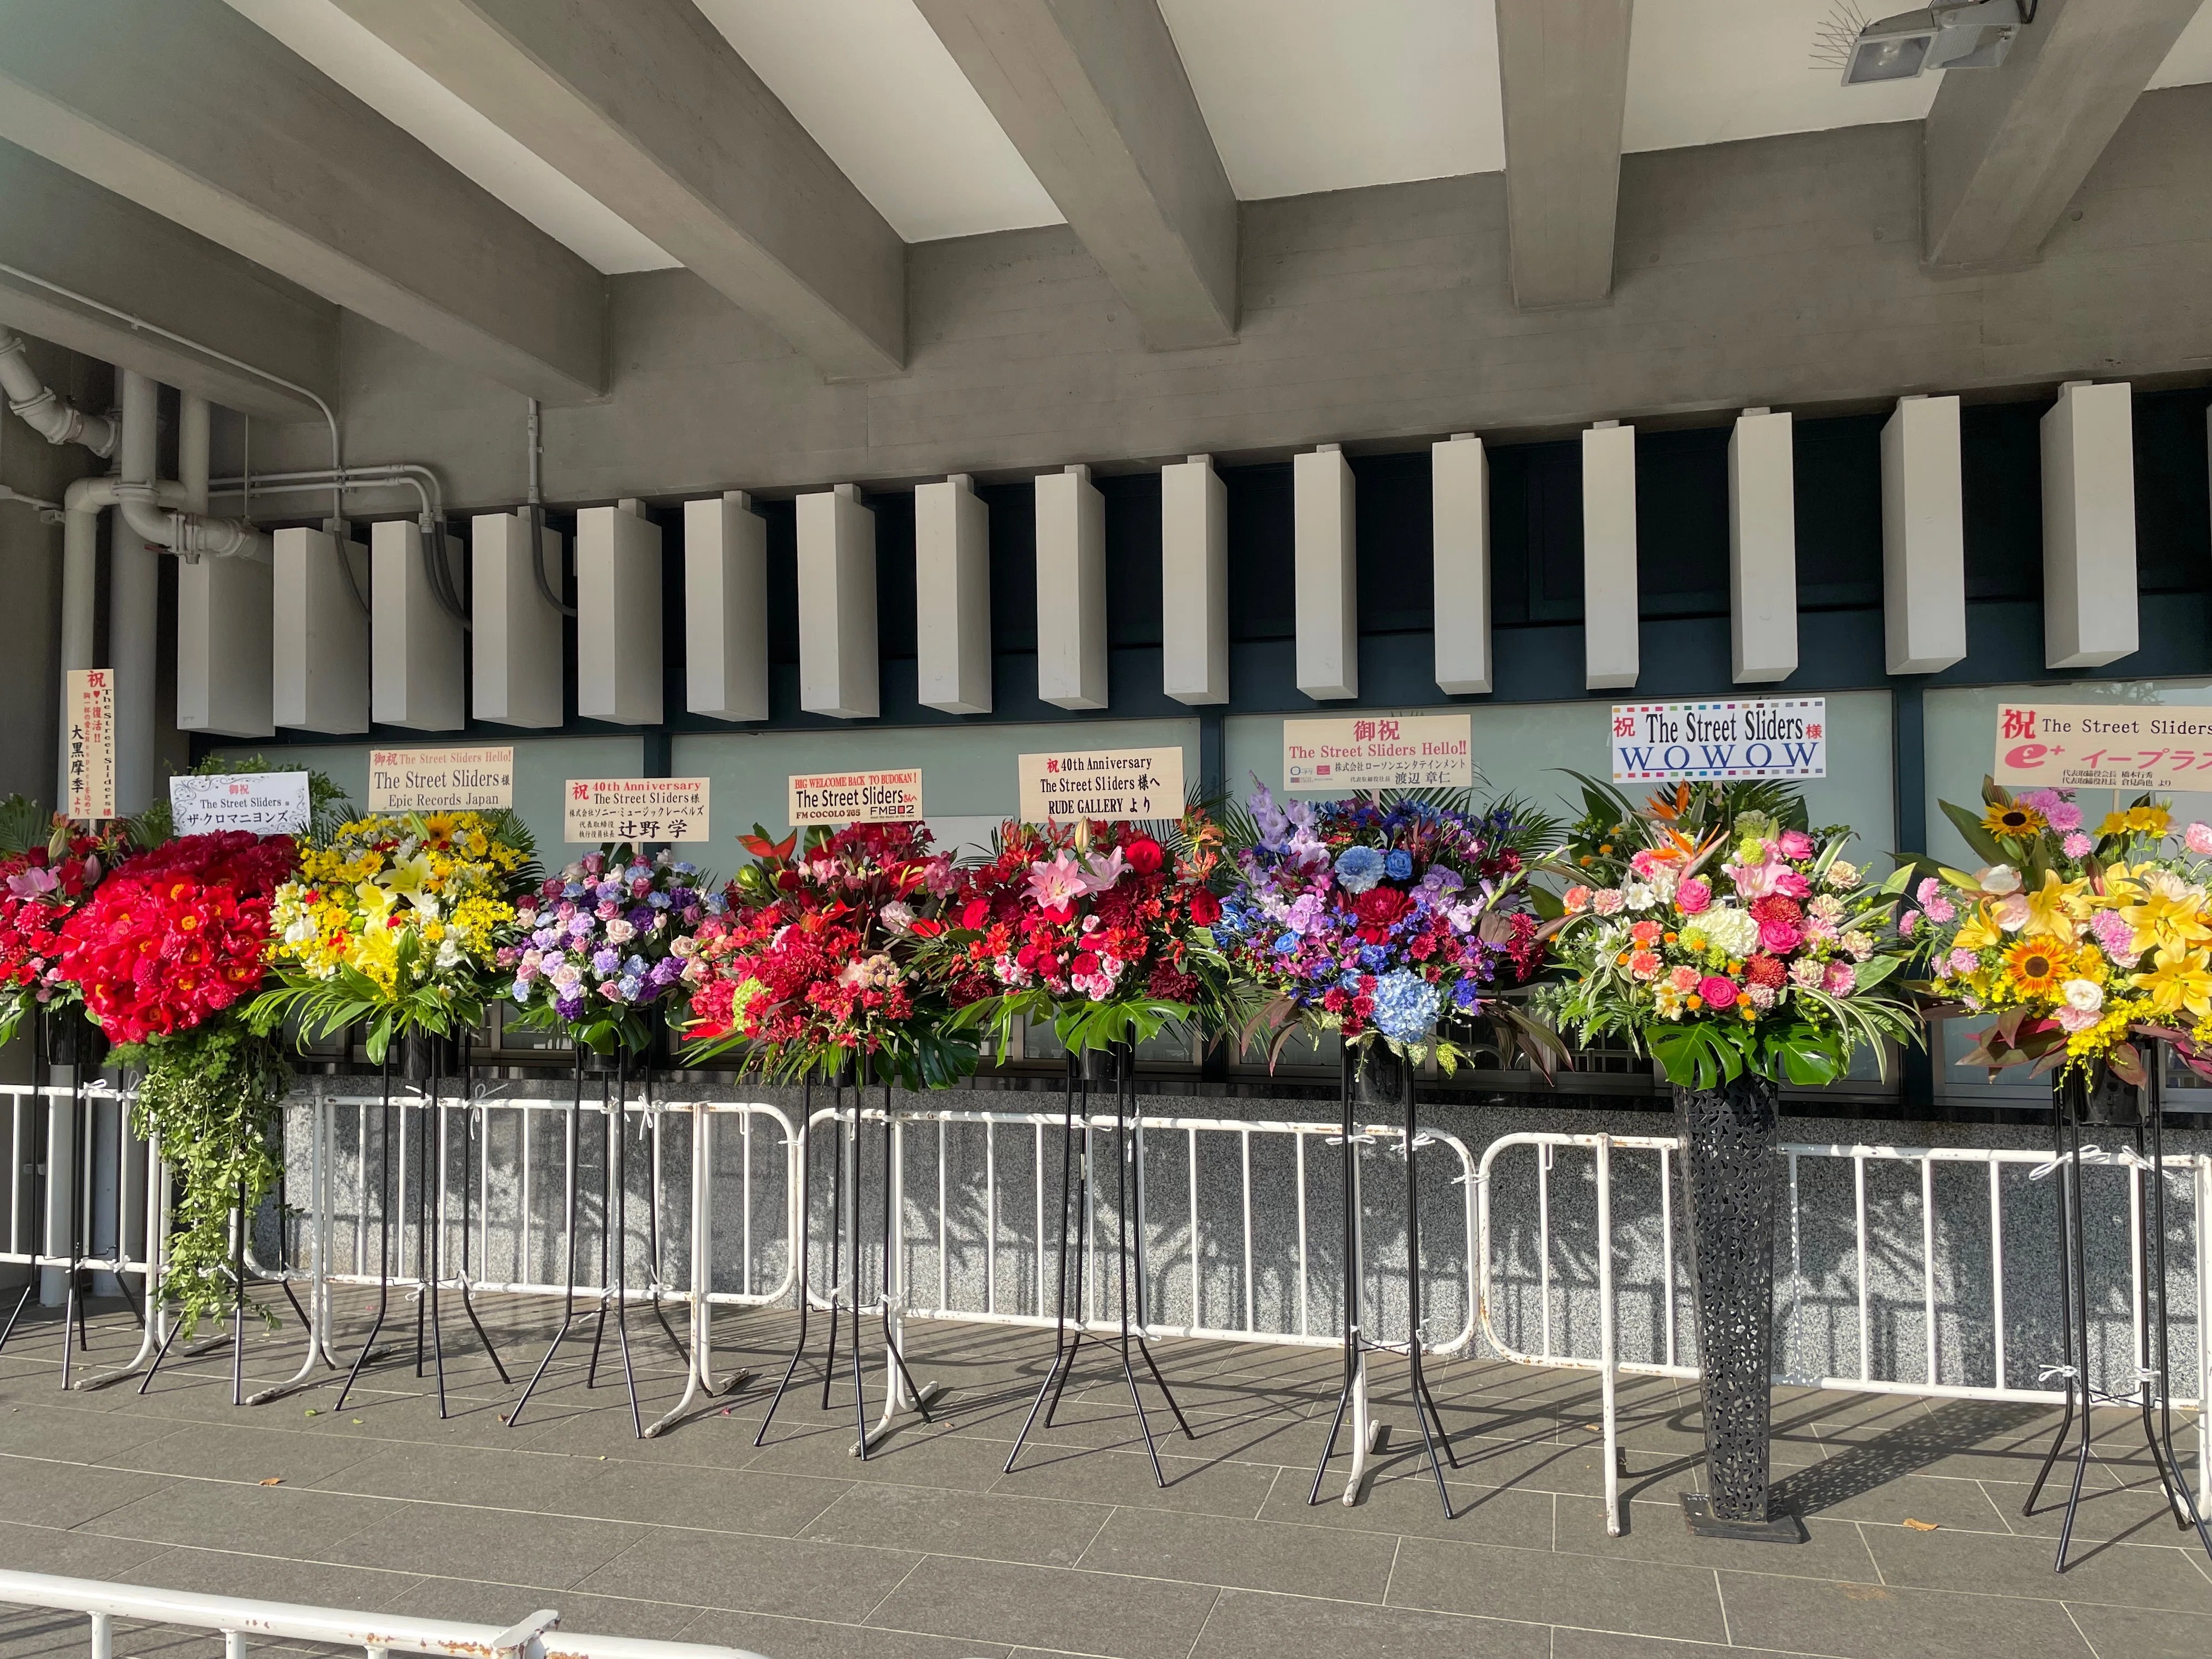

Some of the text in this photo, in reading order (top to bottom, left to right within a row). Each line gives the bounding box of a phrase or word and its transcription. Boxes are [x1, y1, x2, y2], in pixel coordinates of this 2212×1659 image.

[87, 670, 106, 687] 祝
[1353, 720, 1400, 742] 御祝
[1613, 709, 1822, 743] 祝 The Street Sliders 様
[2001, 709, 2036, 740] 祝
[2042, 719, 2071, 732] The
[2083, 719, 2140, 733] Street
[1289, 741, 1466, 758] The Street Sliders Hello!!
[1618, 742, 1819, 771] WOWOW
[71, 725, 84, 793] 大黒摩季
[373, 751, 511, 766] 御祝 The Street Sliders Hello!
[1047, 757, 1152, 773] 祝 40th Anniversary
[374, 769, 510, 789] The Street Sliders 様
[795, 779, 807, 789] BIG
[809, 777, 847, 788] WELCOME
[849, 776, 865, 786] BACK
[869, 775, 879, 785] TO
[1041, 774, 1160, 793] The Street Sliders 様へ
[229, 784, 249, 795] 御祝
[572, 781, 702, 800] 祝 40th Anniversary
[797, 789, 818, 808] The
[822, 789, 859, 806] Street
[862, 786, 903, 804] Sliders
[200, 799, 217, 809] The
[221, 799, 247, 808] Street
[251, 798, 281, 807] Sliders
[389, 793, 498, 808] Epic Records Japan
[594, 793, 699, 804] The Street Sliders 様
[1048, 797, 1150, 814] RUDE GALLERY より
[187, 810, 288, 826] ザ・クロマニヨンズ
[871, 805, 914, 815] FM802
